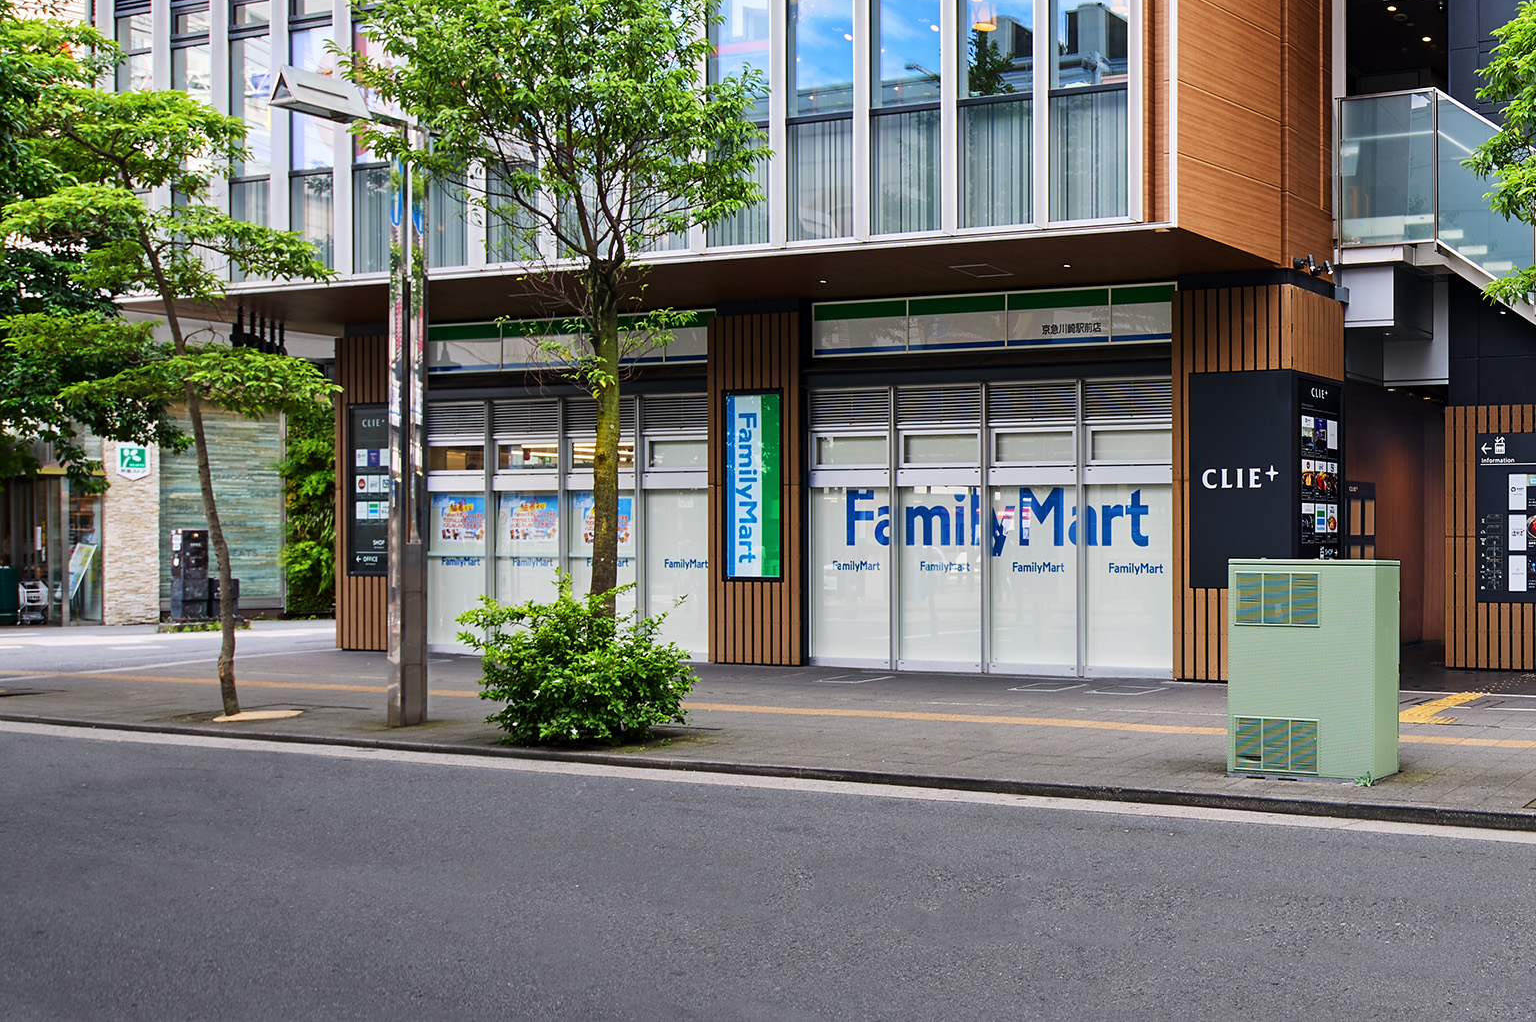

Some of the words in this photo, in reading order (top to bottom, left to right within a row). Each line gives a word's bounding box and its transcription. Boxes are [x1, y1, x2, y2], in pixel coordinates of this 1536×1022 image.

[1041, 322, 1102, 335] 京急川崎駅前店
[735, 412, 758, 564] FamilyMart
[844, 486, 1150, 558] FamilyMart
[441, 557, 481, 568] FamilyMart
[512, 557, 553, 568] FamilyMart
[664, 558, 708, 570] FamilyMart
[832, 560, 881, 572] FamilyMart
[919, 560, 970, 573] FamilyMart
[1012, 560, 1065, 574] FamilyMart
[1108, 561, 1164, 575] FamilyMart
